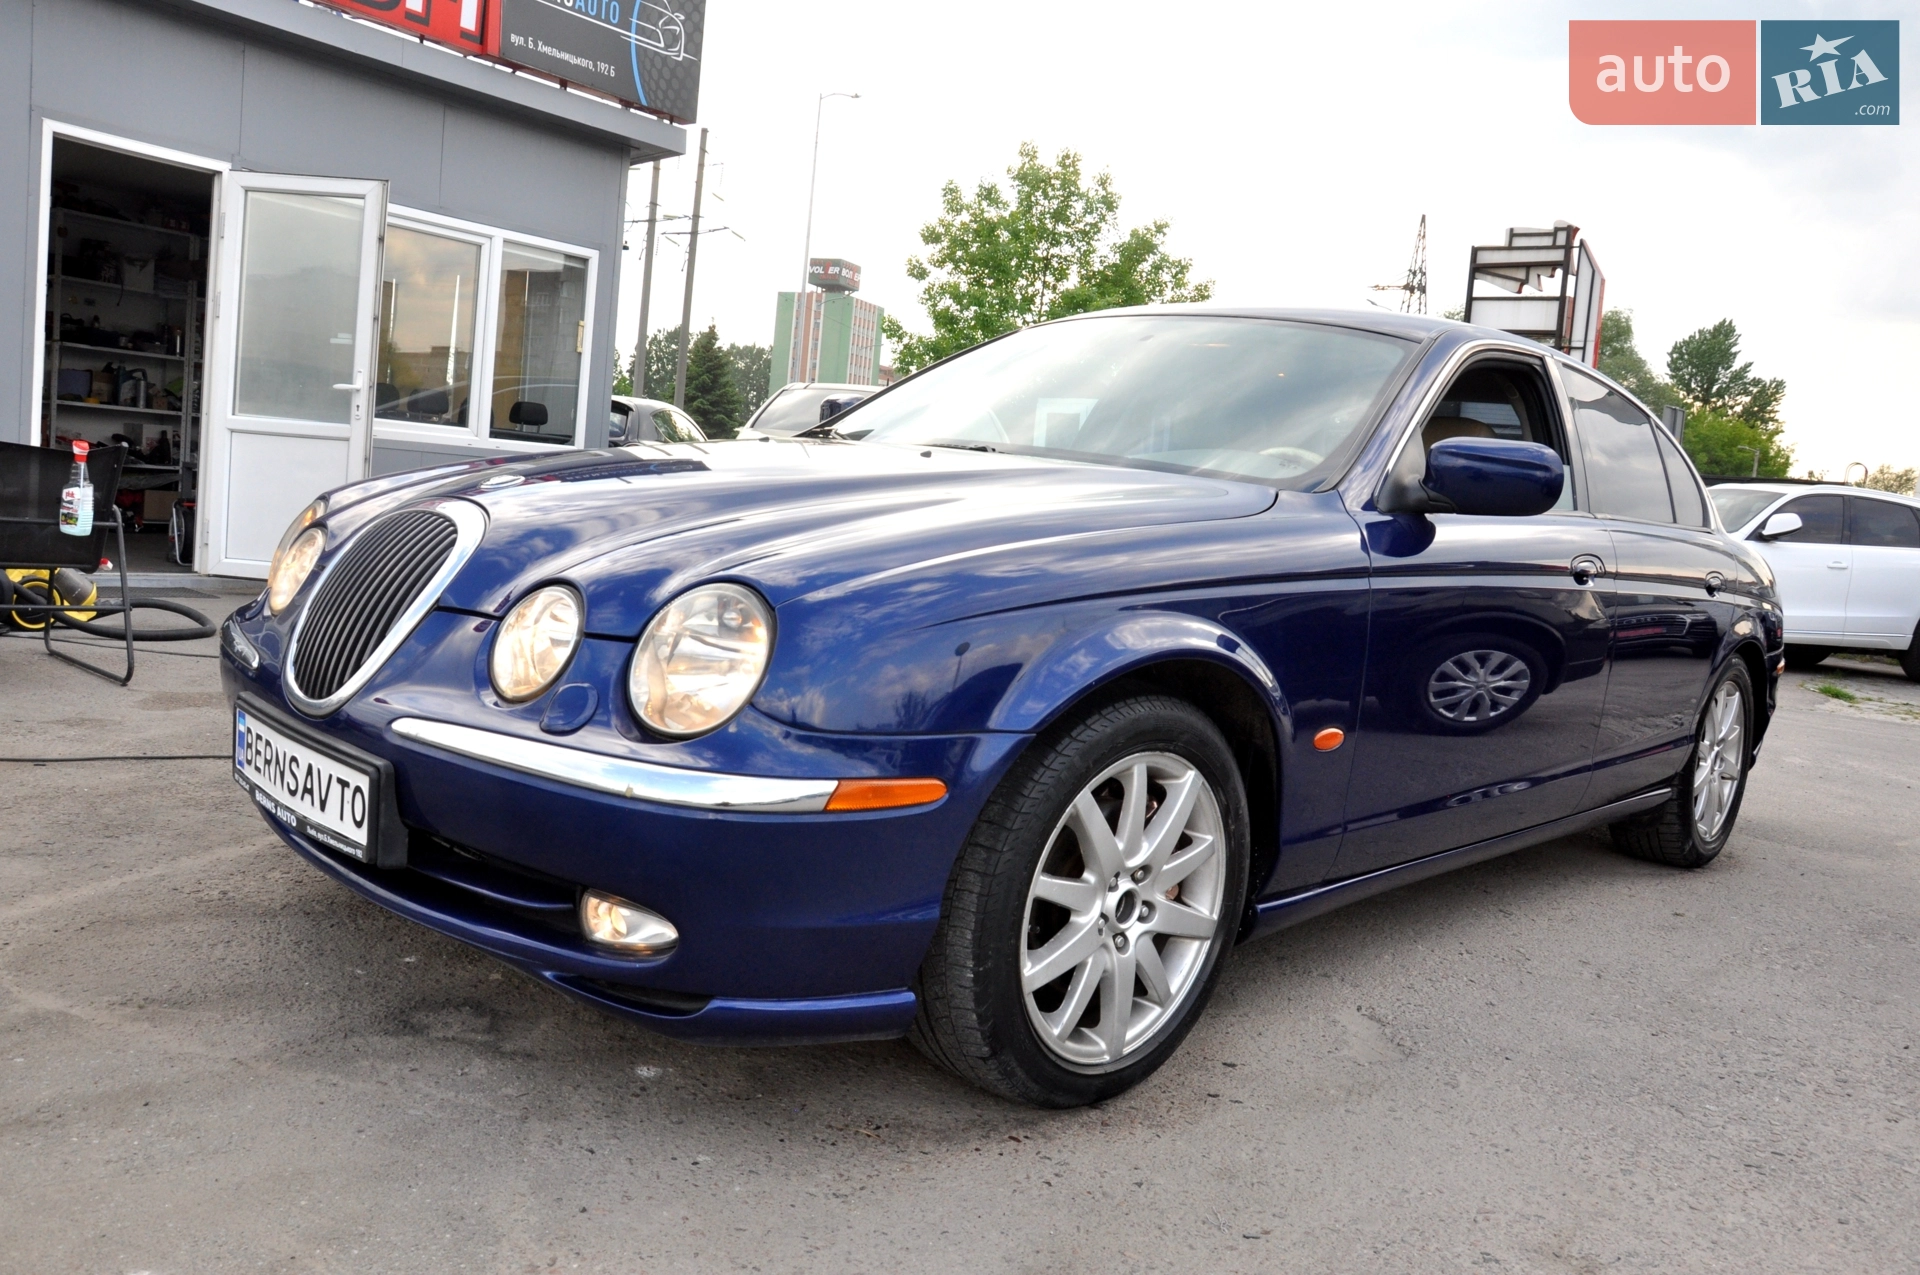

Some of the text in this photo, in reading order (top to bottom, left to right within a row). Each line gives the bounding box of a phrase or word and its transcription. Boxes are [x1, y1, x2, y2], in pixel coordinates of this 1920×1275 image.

[510, 33, 616, 77] вул. Б. Хмельницького, 192 Б
[245, 726, 366, 829] BERNSAVTO
[255, 789, 297, 827] BERNS AUTO
